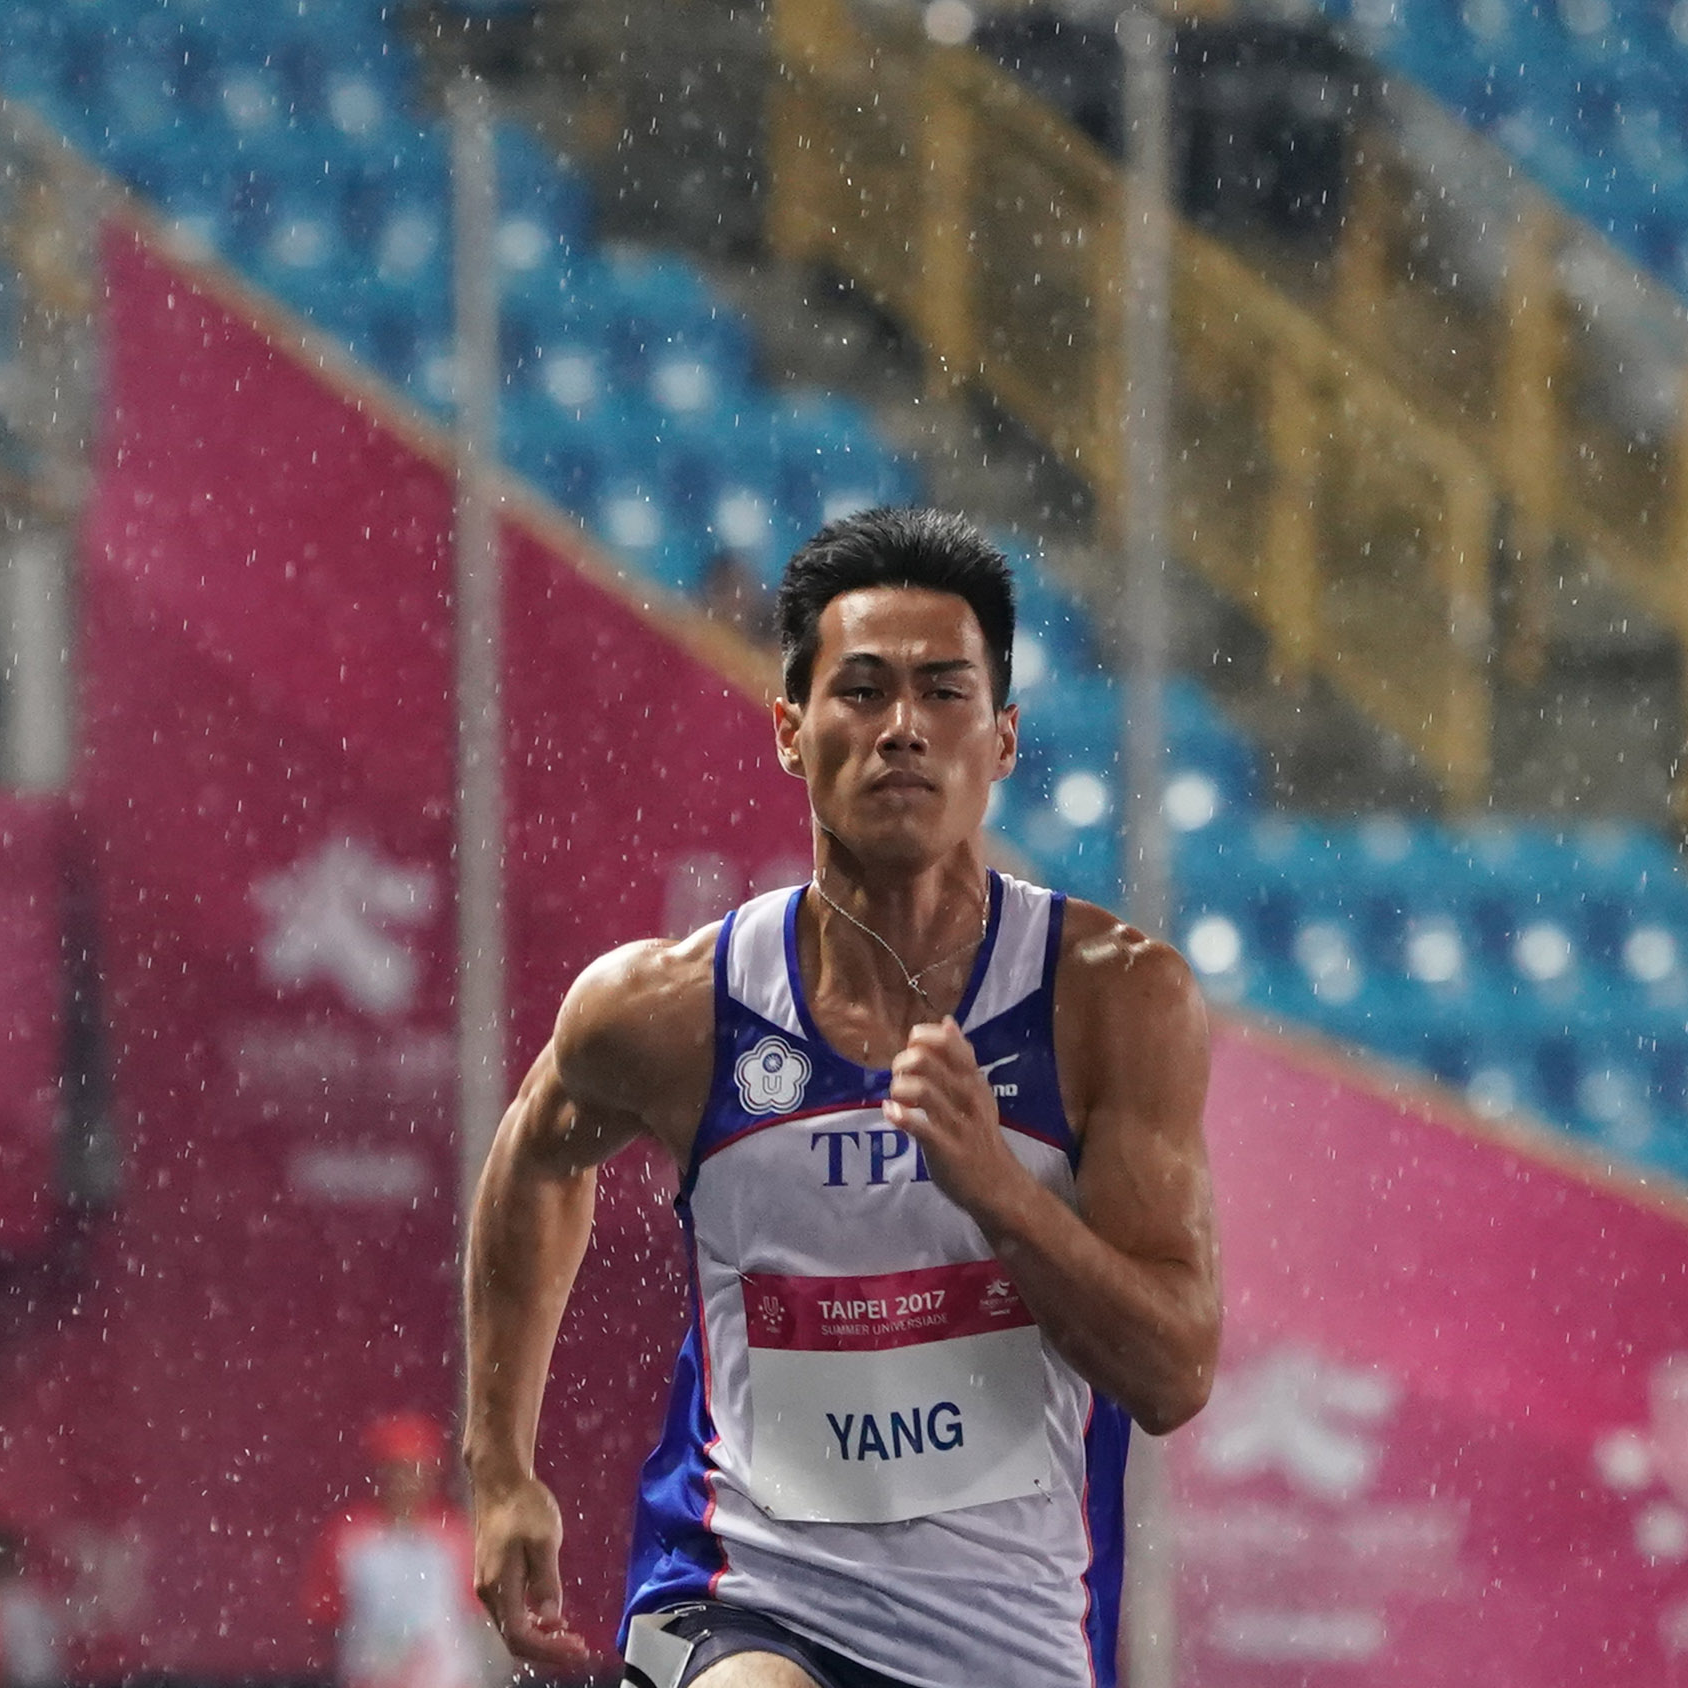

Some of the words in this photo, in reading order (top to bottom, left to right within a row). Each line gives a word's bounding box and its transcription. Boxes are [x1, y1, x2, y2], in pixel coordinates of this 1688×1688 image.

[817, 1299, 888, 1320] TAIPEI
[895, 1289, 946, 1316] 2017
[821, 1324, 870, 1336] SUMMER
[872, 1313, 949, 1336] UNIVERSIADE
[826, 1401, 964, 1461] YANG
